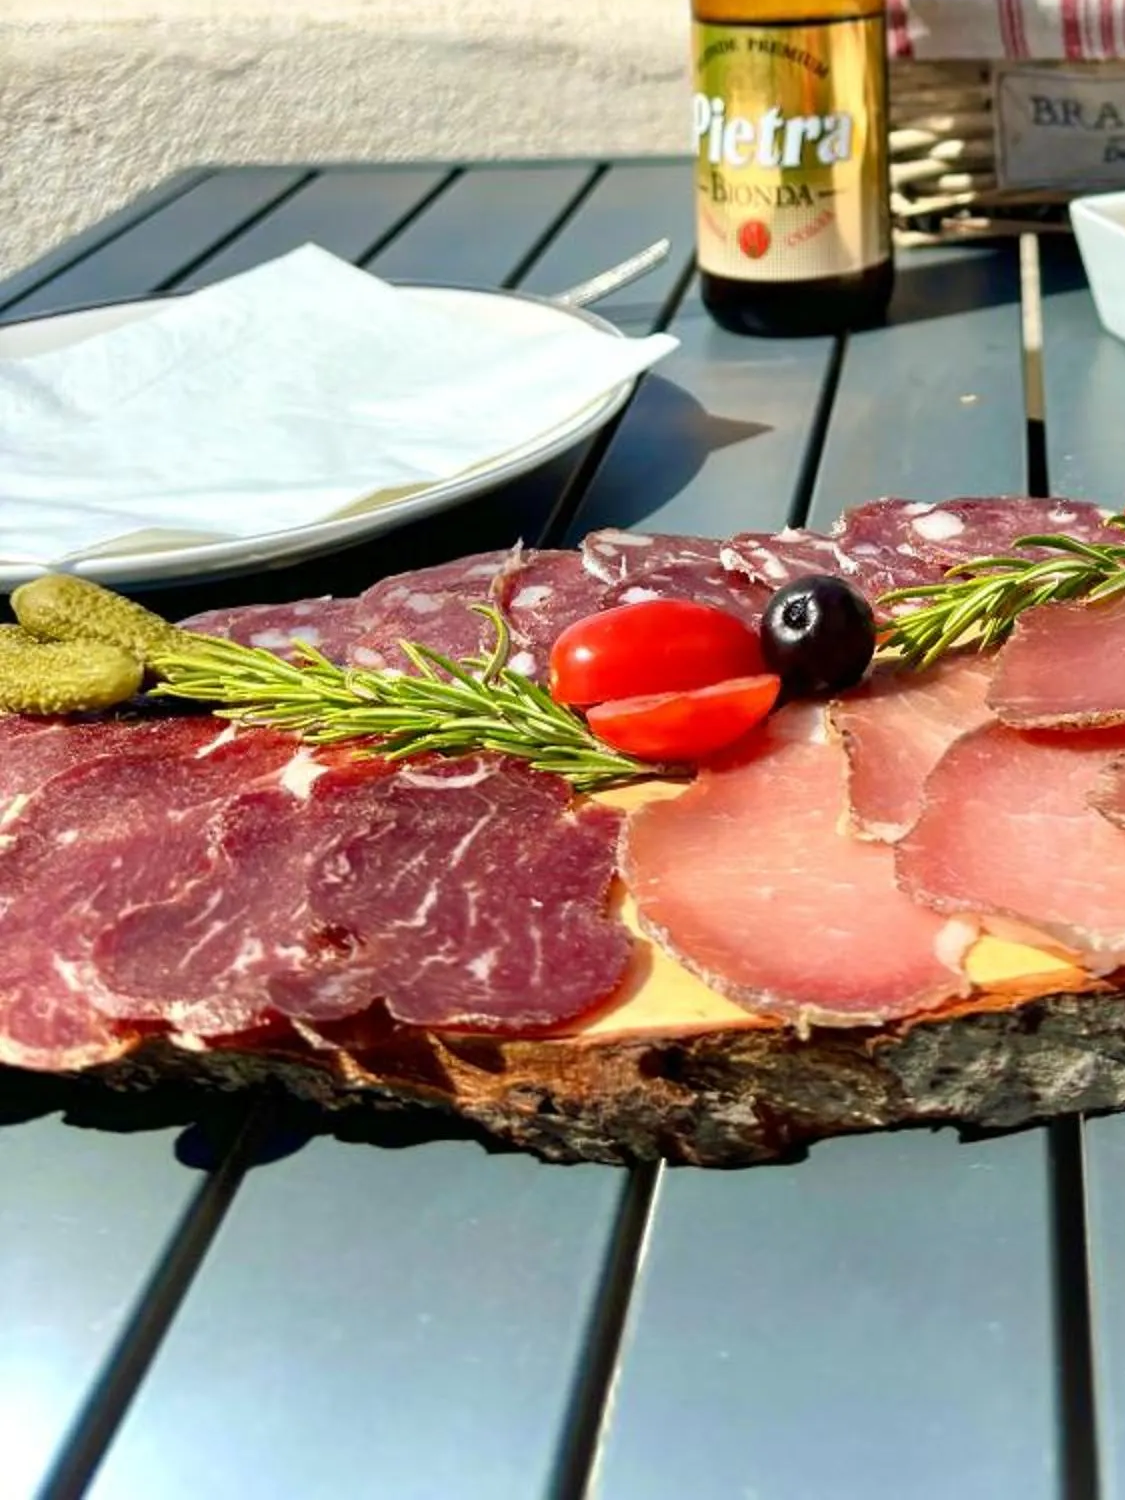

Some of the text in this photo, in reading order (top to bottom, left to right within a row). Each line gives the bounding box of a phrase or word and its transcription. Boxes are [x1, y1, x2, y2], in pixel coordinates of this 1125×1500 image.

[747, 37, 830, 80] PREMIUM
[691, 90, 852, 168] Pietra
[710, 170, 814, 207] BIONDA
